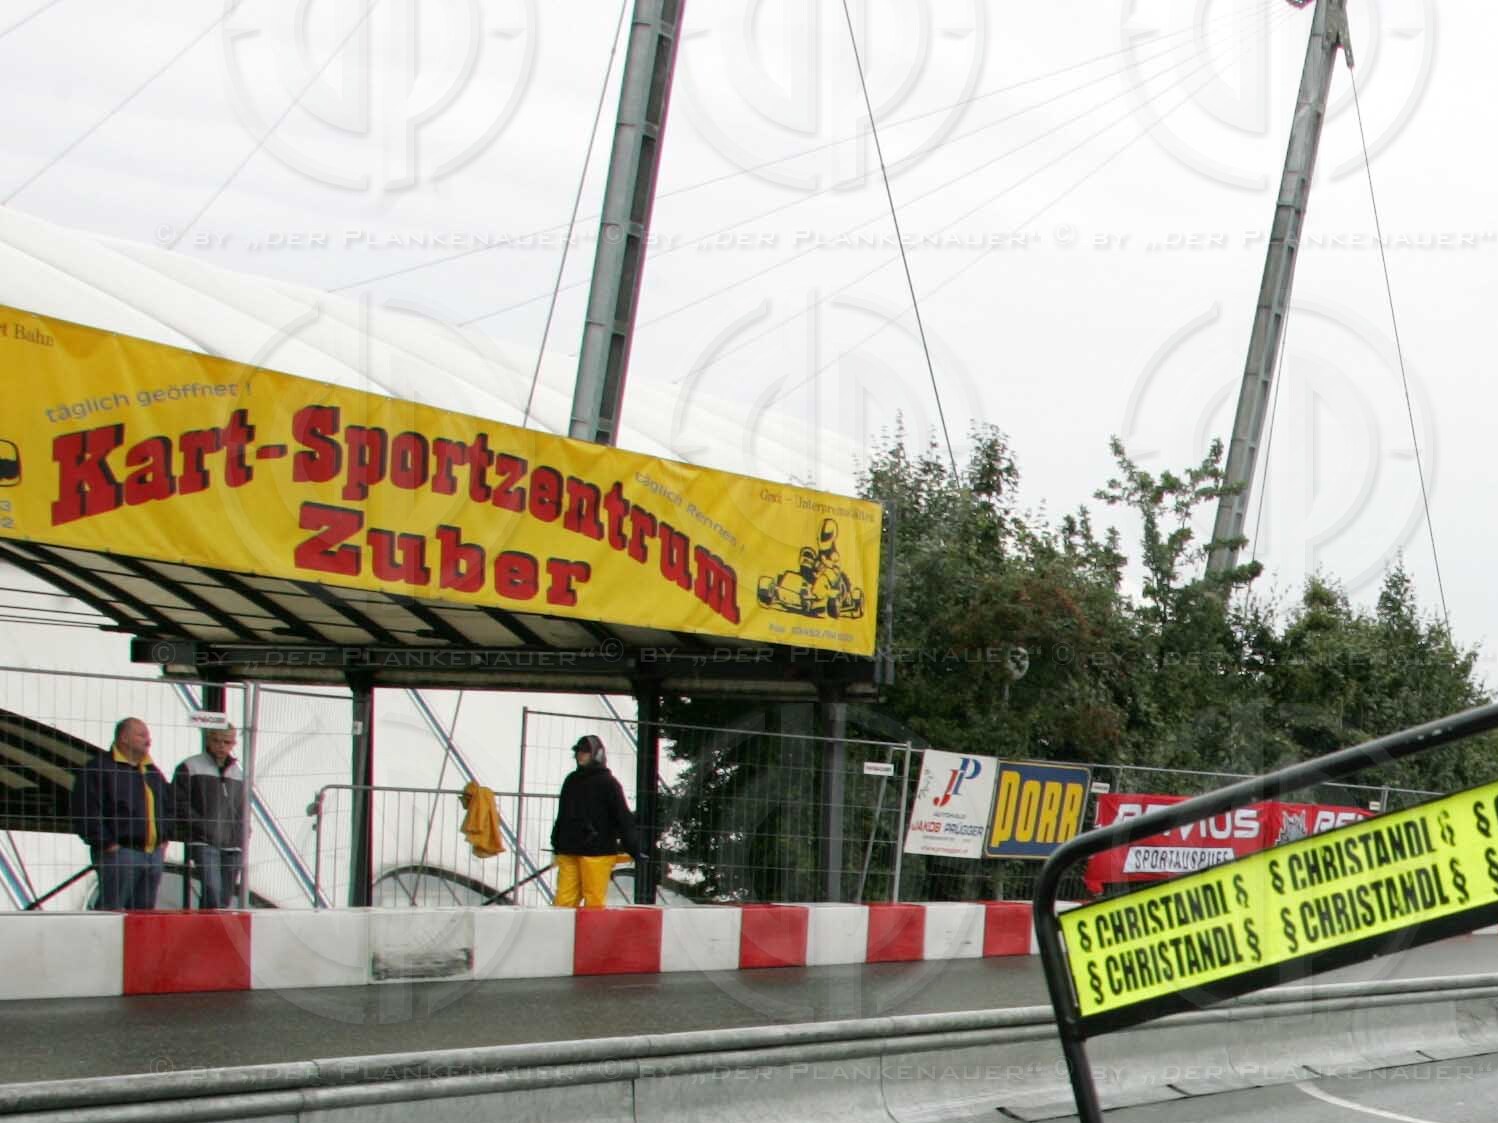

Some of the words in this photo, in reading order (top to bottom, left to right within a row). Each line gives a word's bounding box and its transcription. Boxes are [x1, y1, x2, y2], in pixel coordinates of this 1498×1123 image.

[46, 392, 129, 424] täglich
[136, 383, 238, 408] geöffnet
[51, 405, 741, 626] Kart-Sportzentrum
[293, 500, 592, 607] Zuber
[1288, 816, 1438, 892] CHRISTANDL
[1095, 880, 1231, 950] CHRISTANDL
[1300, 864, 1451, 944] CHRISTANDL
[1105, 923, 1244, 996] CHRISTANDL
